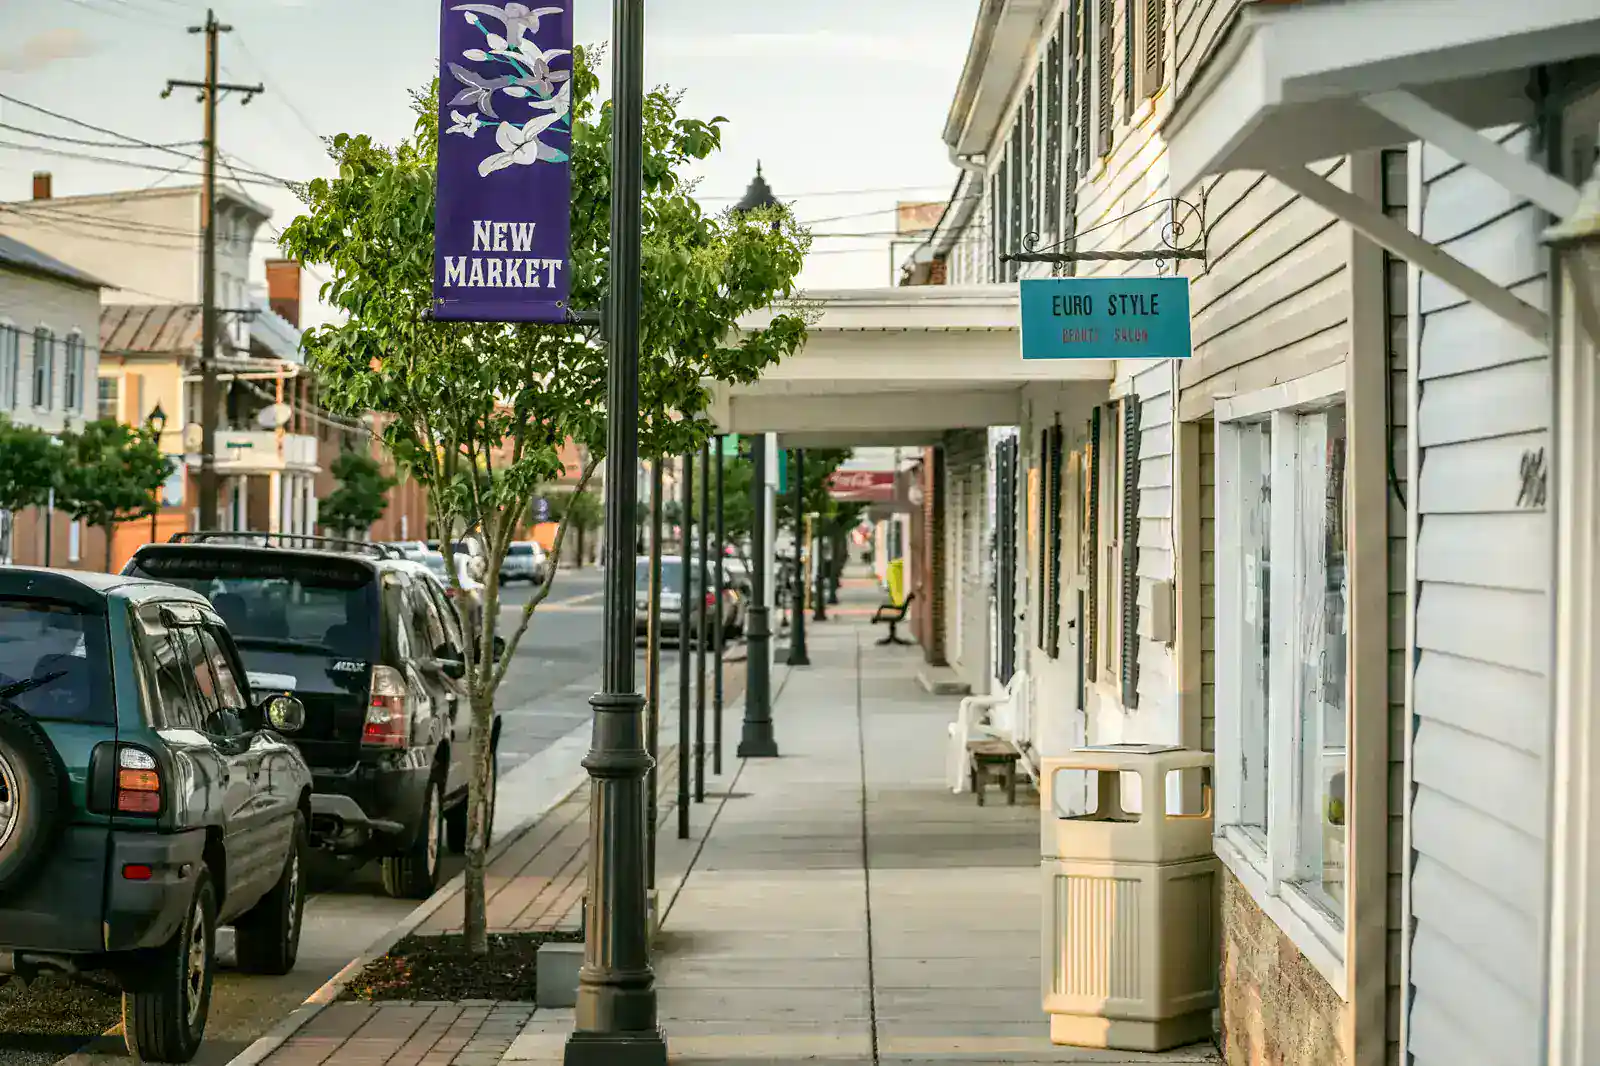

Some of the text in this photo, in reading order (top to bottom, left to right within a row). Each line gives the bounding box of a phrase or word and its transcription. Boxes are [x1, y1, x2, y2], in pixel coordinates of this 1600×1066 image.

[472, 220, 536, 252] NEW
[443, 256, 563, 288] MARKET
[1052, 293, 1159, 316] EURO STYLE
